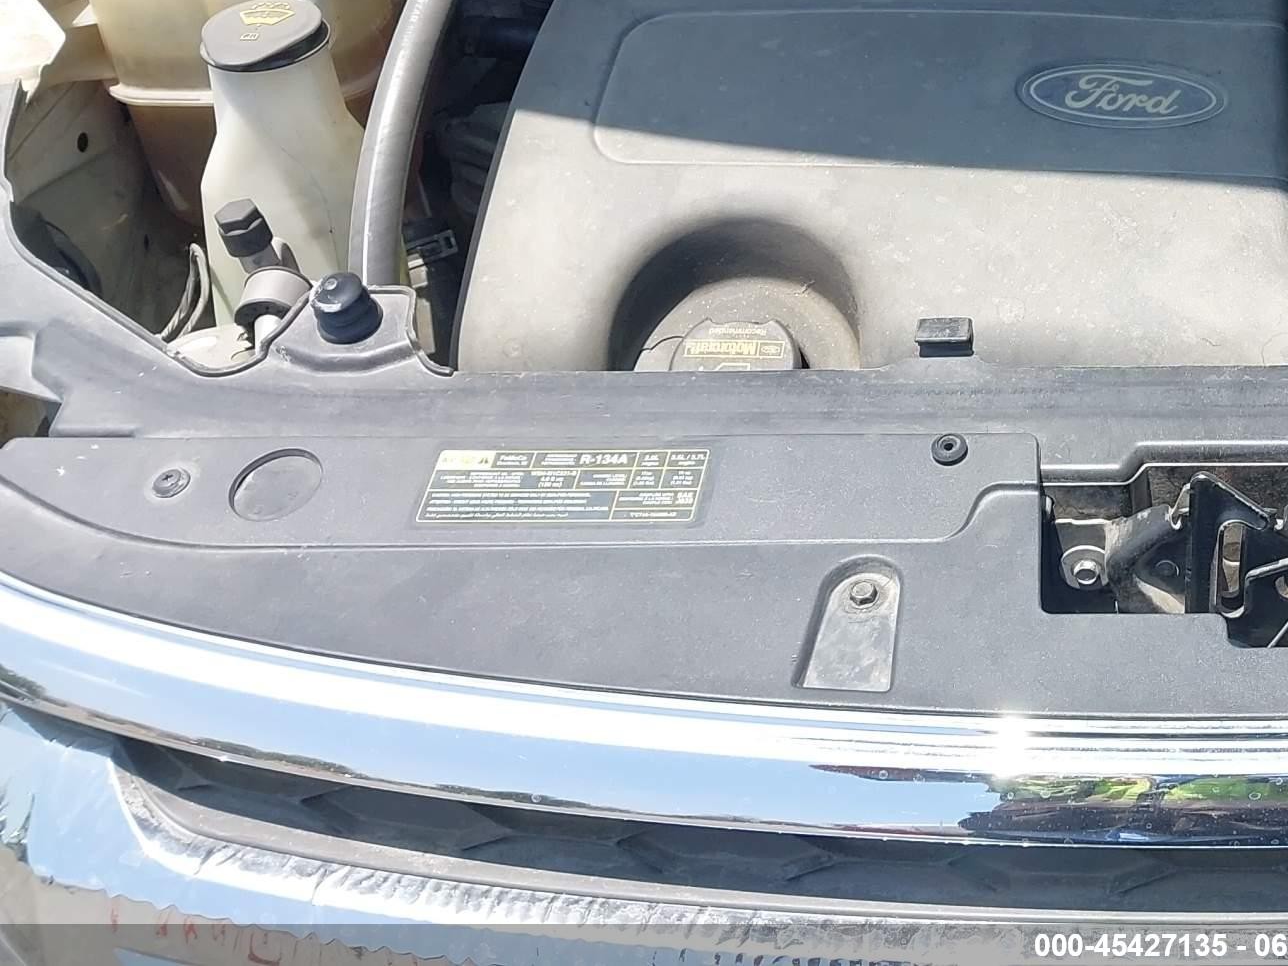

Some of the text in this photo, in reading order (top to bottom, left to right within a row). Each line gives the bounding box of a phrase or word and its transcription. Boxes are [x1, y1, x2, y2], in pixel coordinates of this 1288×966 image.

[1064, 73, 1182, 115] Ford
[690, 341, 757, 355] Motorcraft
[579, 453, 629, 465] R-134A
